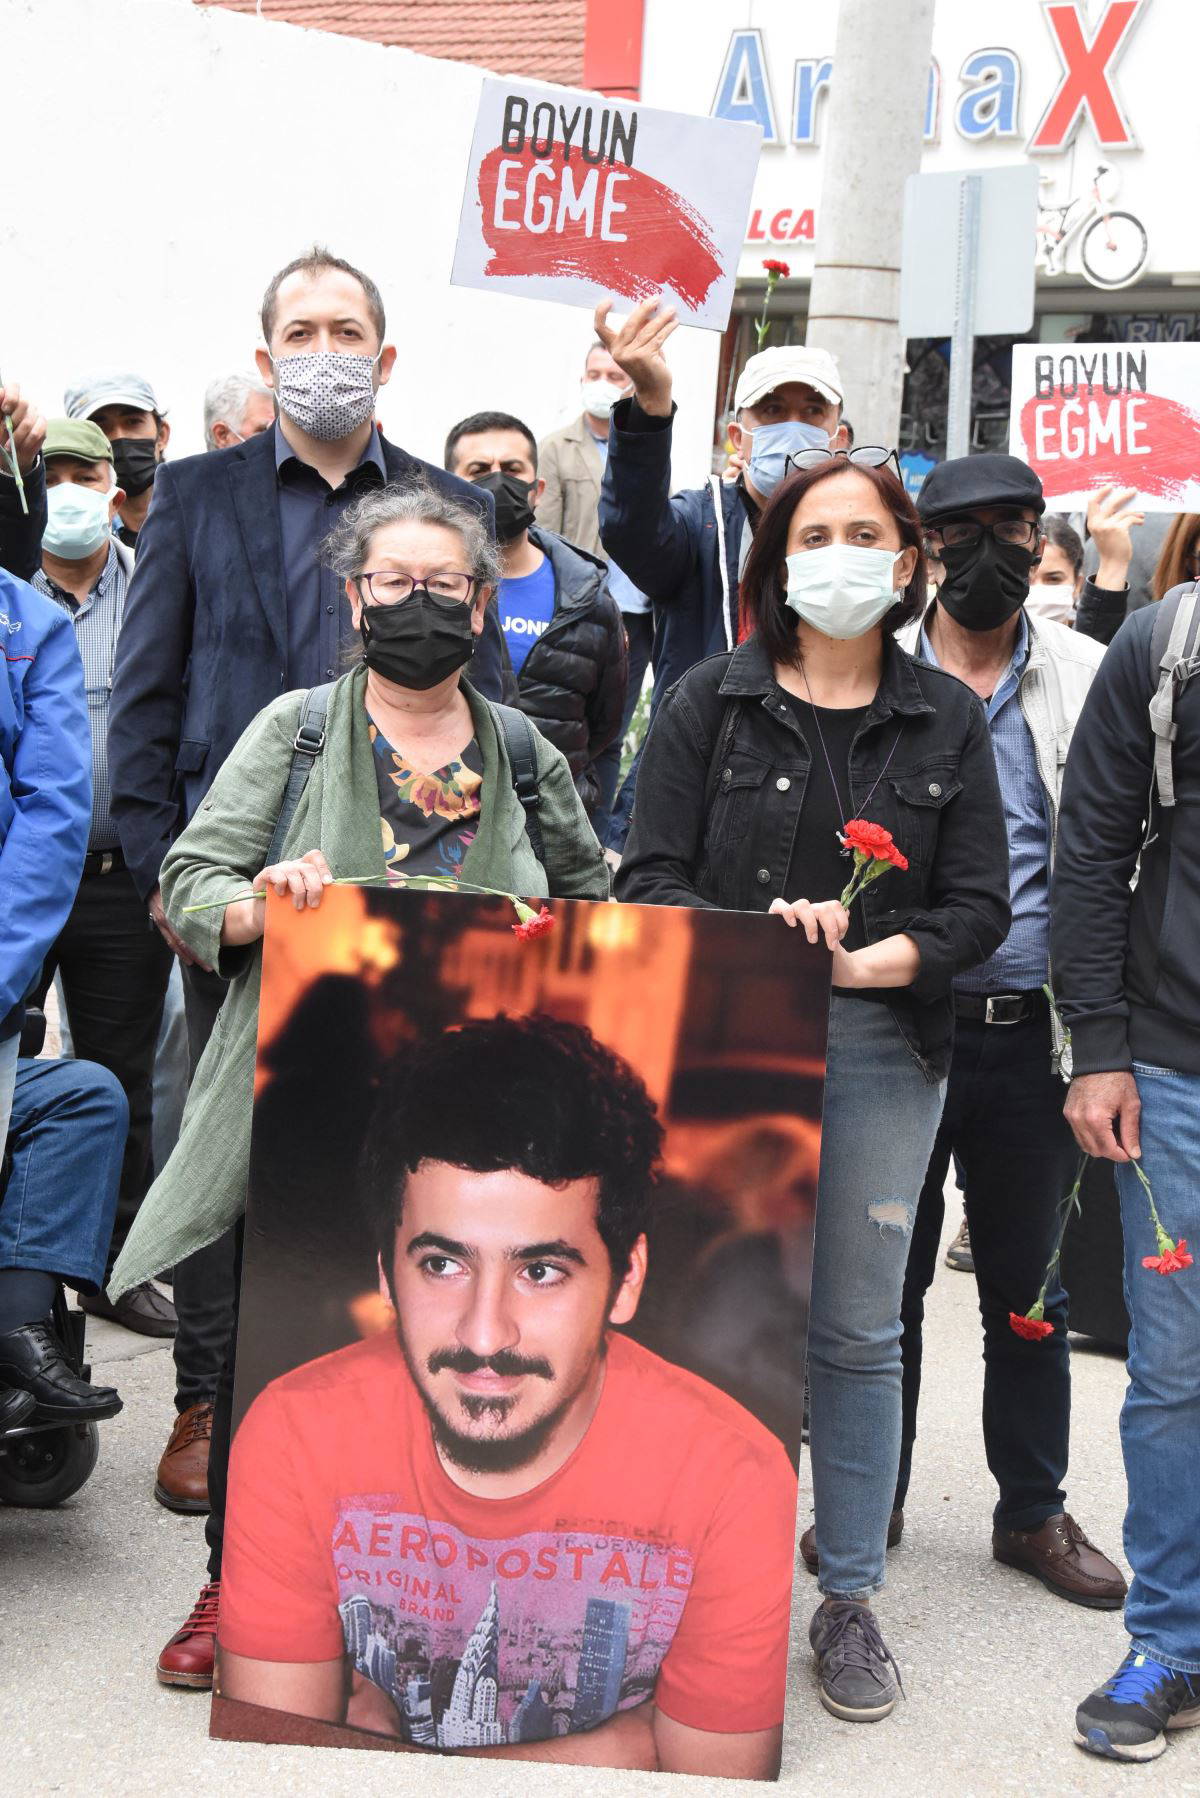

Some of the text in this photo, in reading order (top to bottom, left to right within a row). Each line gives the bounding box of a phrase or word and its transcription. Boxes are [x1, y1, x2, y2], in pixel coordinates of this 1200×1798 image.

[708, 1, 1142, 153] AraX
[501, 95, 638, 168] BOYUN
[493, 159, 632, 242] EĞME
[747, 208, 815, 240] LCA
[1035, 349, 1147, 400] BOYUN
[1034, 397, 1152, 461] EĞME
[337, 1563, 462, 1603] ORIGINAL
[400, 1598, 455, 1622] BRAND
